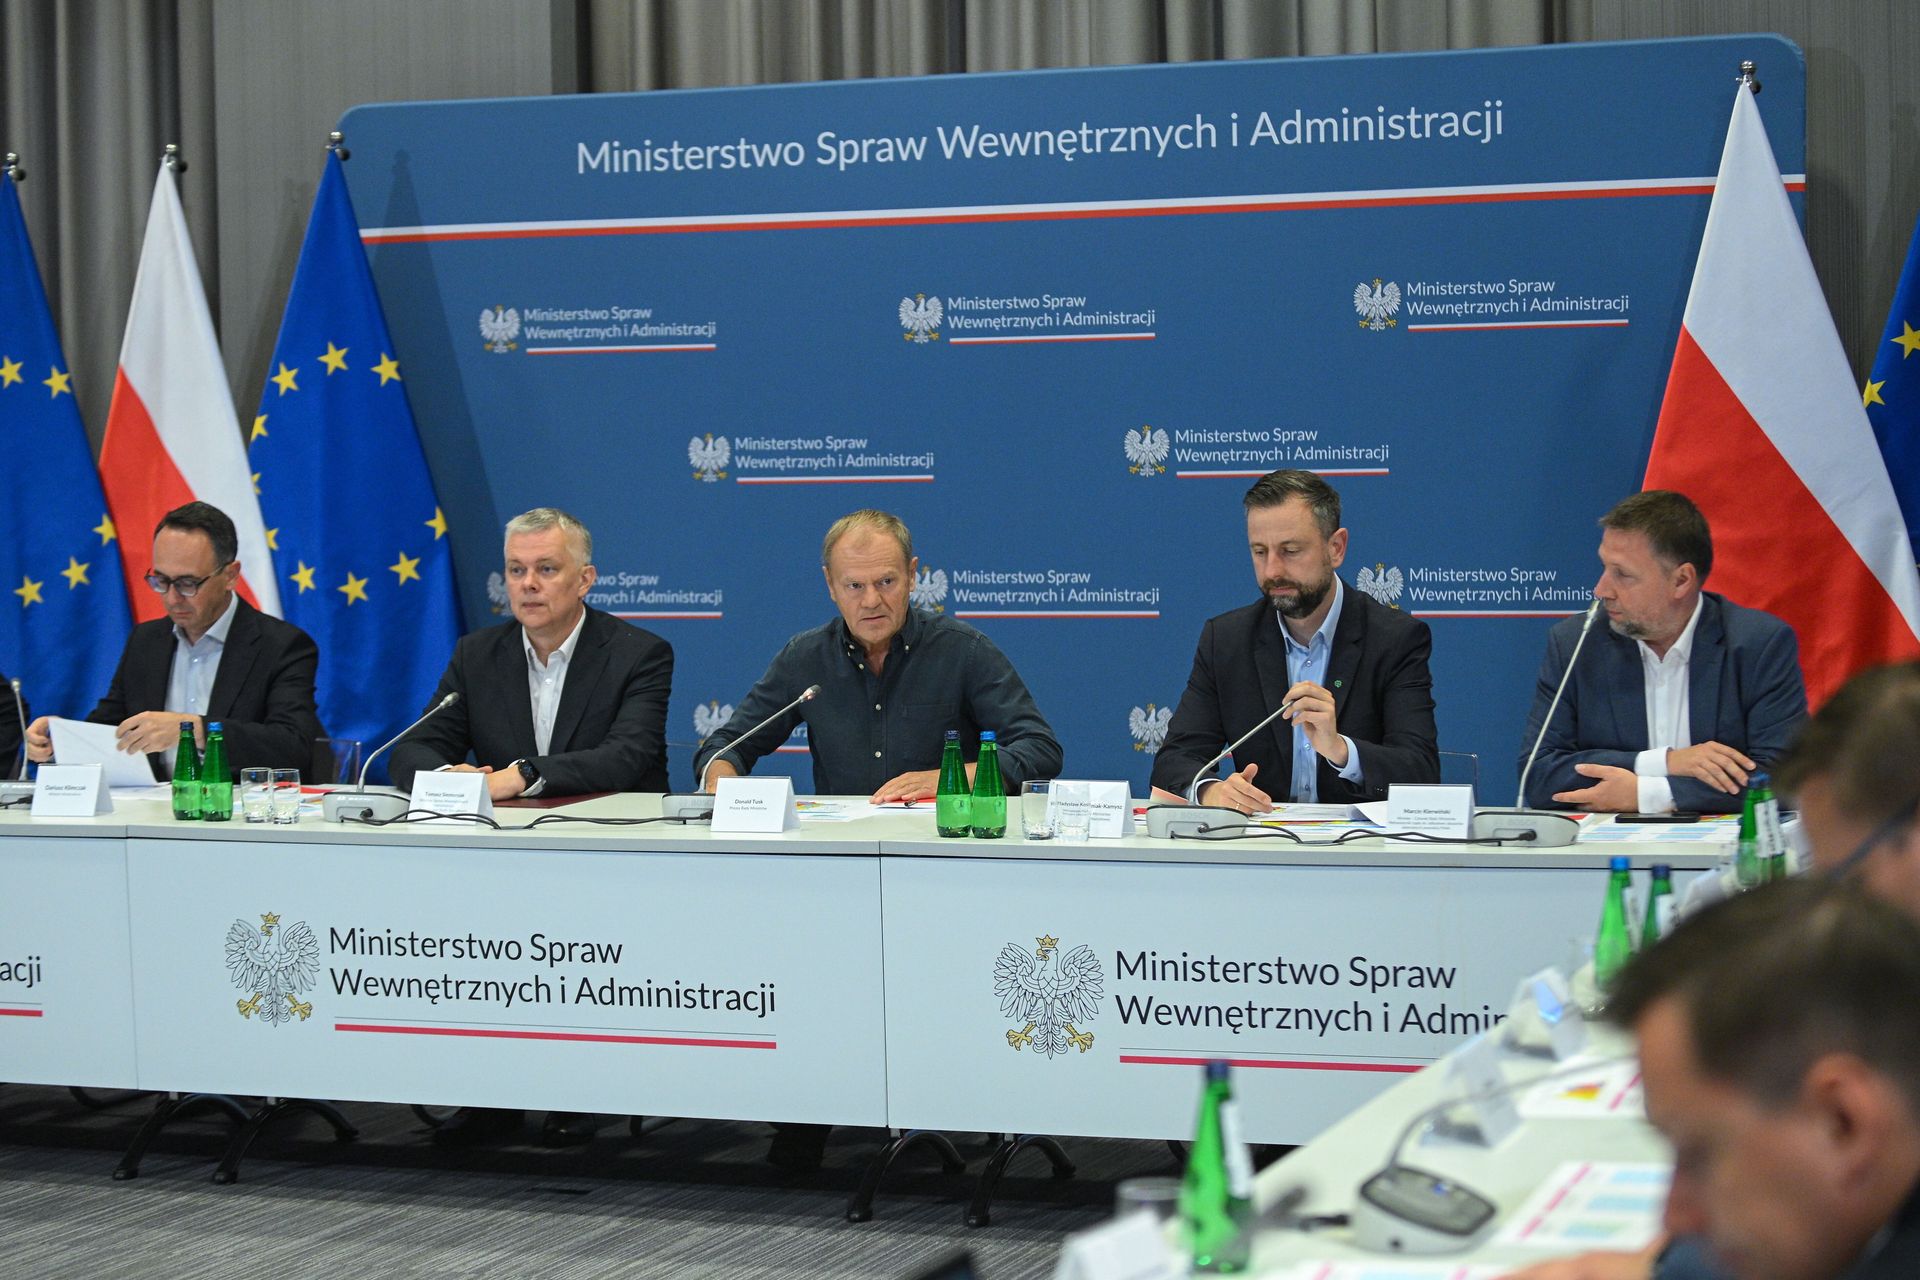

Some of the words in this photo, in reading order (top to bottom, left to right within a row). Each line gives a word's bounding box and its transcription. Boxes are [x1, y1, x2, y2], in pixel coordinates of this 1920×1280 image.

[578, 138, 804, 174] Ministerstwo
[817, 132, 927, 171] Spraw
[937, 114, 1216, 161] Wewnętrznych
[1231, 113, 1237, 146] i
[1250, 100, 1502, 146] Administracji
[1408, 282, 1505, 296] Ministerstwo
[1509, 279, 1555, 295] Spraw
[948, 297, 1039, 310] Ministerstwo
[1043, 294, 1086, 310] Spraw
[1407, 298, 1518, 317] Wewnętrznych
[1523, 298, 1526, 312] i
[1530, 295, 1628, 312] Administracji
[524, 308, 609, 321] Ministerstwo
[611, 306, 652, 321] Spraw
[948, 313, 1052, 330] Wewnętrznych
[1056, 313, 1059, 326] i
[1063, 310, 1155, 326] Administracji
[524, 324, 622, 341] Wewnętrznych
[624, 324, 628, 337] i
[630, 322, 716, 338] Administracji
[735, 437, 823, 450] Ministerstwo
[826, 436, 867, 451] Spraw
[1176, 429, 1269, 443] Ministerstwo
[1273, 428, 1317, 444] Spraw
[735, 454, 835, 470] Wewnętrznych
[839, 454, 842, 467] i
[845, 453, 934, 469] Administracji
[1175, 447, 1283, 464] Wewnętrznych
[1287, 447, 1290, 460] i
[1294, 445, 1388, 462] Administracji
[618, 572, 659, 588] Spraw
[953, 570, 1044, 584] Ministerstwo
[1048, 570, 1090, 586] Spraw
[1410, 568, 1506, 582] Ministerstwo
[1511, 567, 1556, 584] Spraw
[630, 590, 635, 603] i
[637, 590, 722, 606] Administracji
[953, 588, 1057, 605] Wewnętrznych
[1061, 588, 1064, 601] i
[1068, 588, 1159, 604] Administracji
[1409, 587, 1520, 603] Wewnętrznych
[1525, 587, 1528, 600] i
[330, 927, 522, 960] Ministerstwo
[531, 934, 622, 968] Spraw
[1117, 951, 1339, 985] Ministerstwo
[1349, 957, 1456, 993] Spraw
[330, 966, 554, 1007] Wewnętrznych
[560, 976, 565, 1003] i
[575, 977, 774, 1018] Administracji
[1115, 992, 1375, 1037] Wewnętrznych
[1383, 1002, 1389, 1032] i
